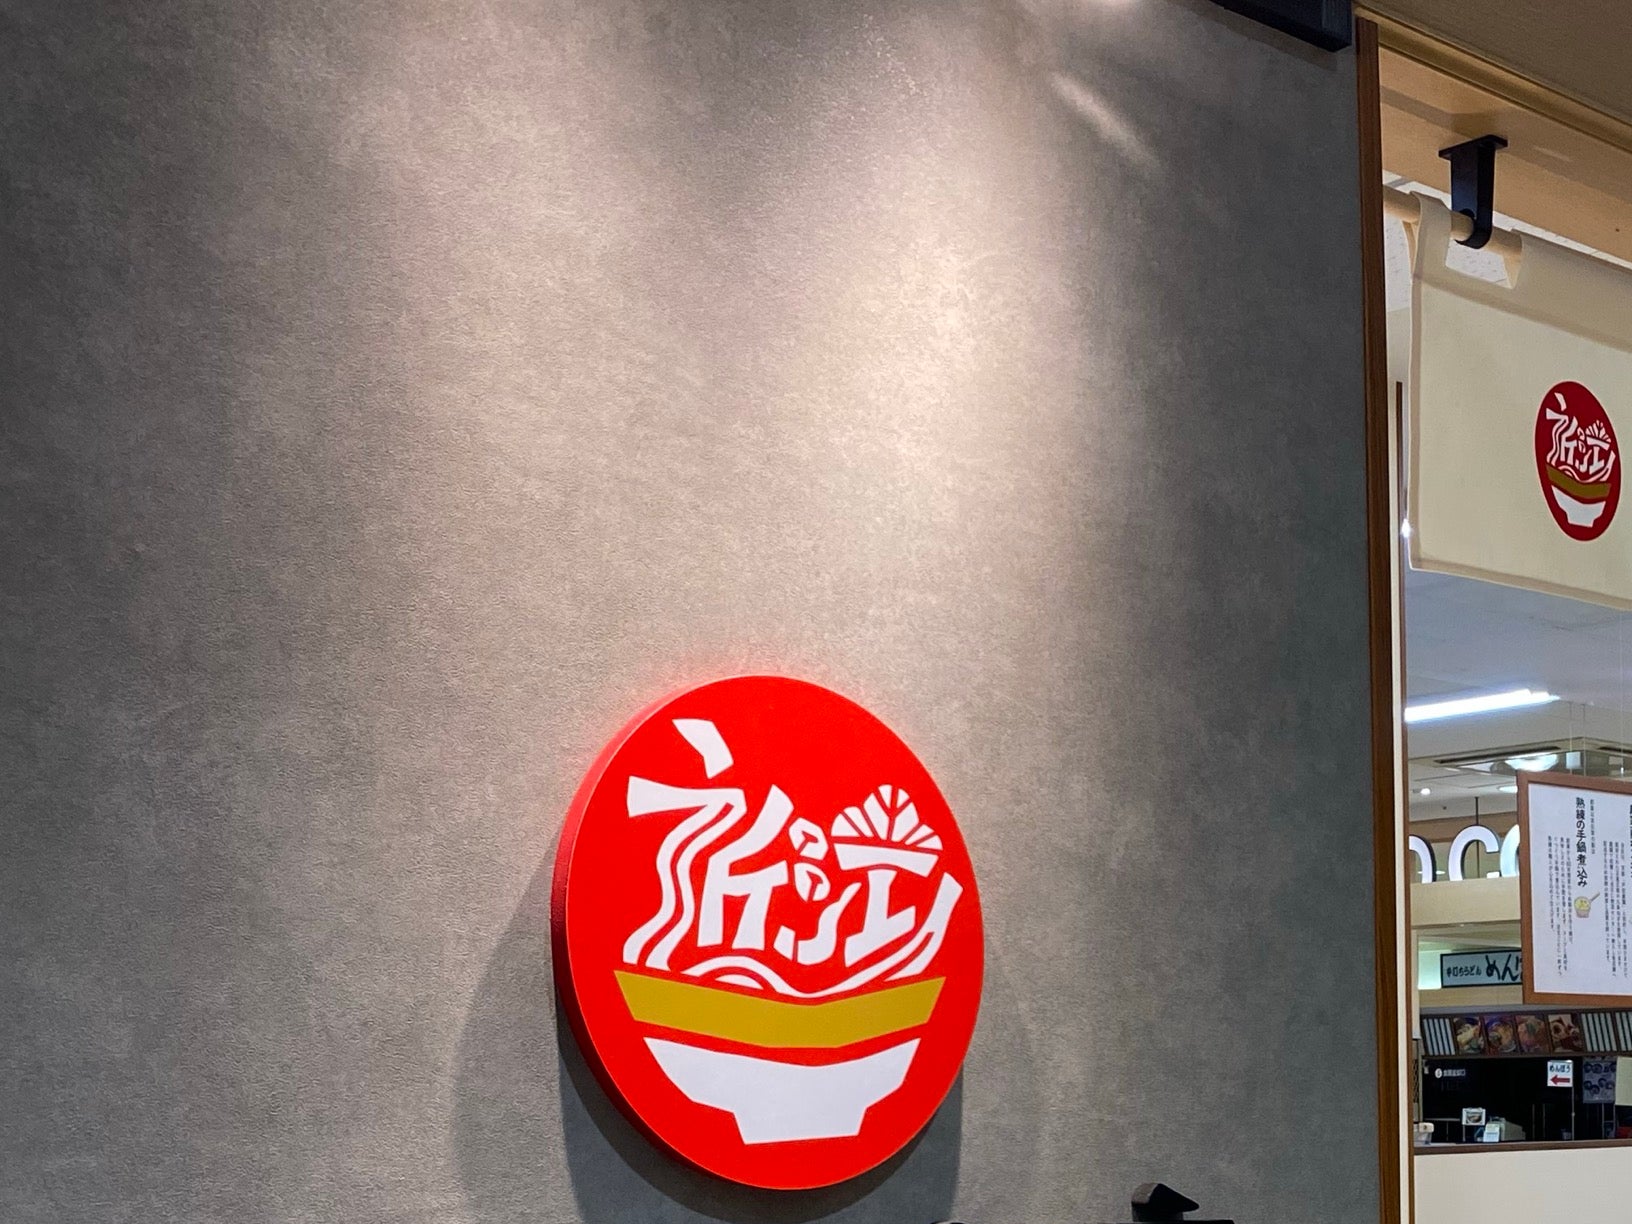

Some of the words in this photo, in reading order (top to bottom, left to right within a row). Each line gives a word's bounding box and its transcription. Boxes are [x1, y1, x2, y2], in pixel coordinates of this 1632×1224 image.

[1576, 796, 1588, 888] 熟練の手鍋煮込み
